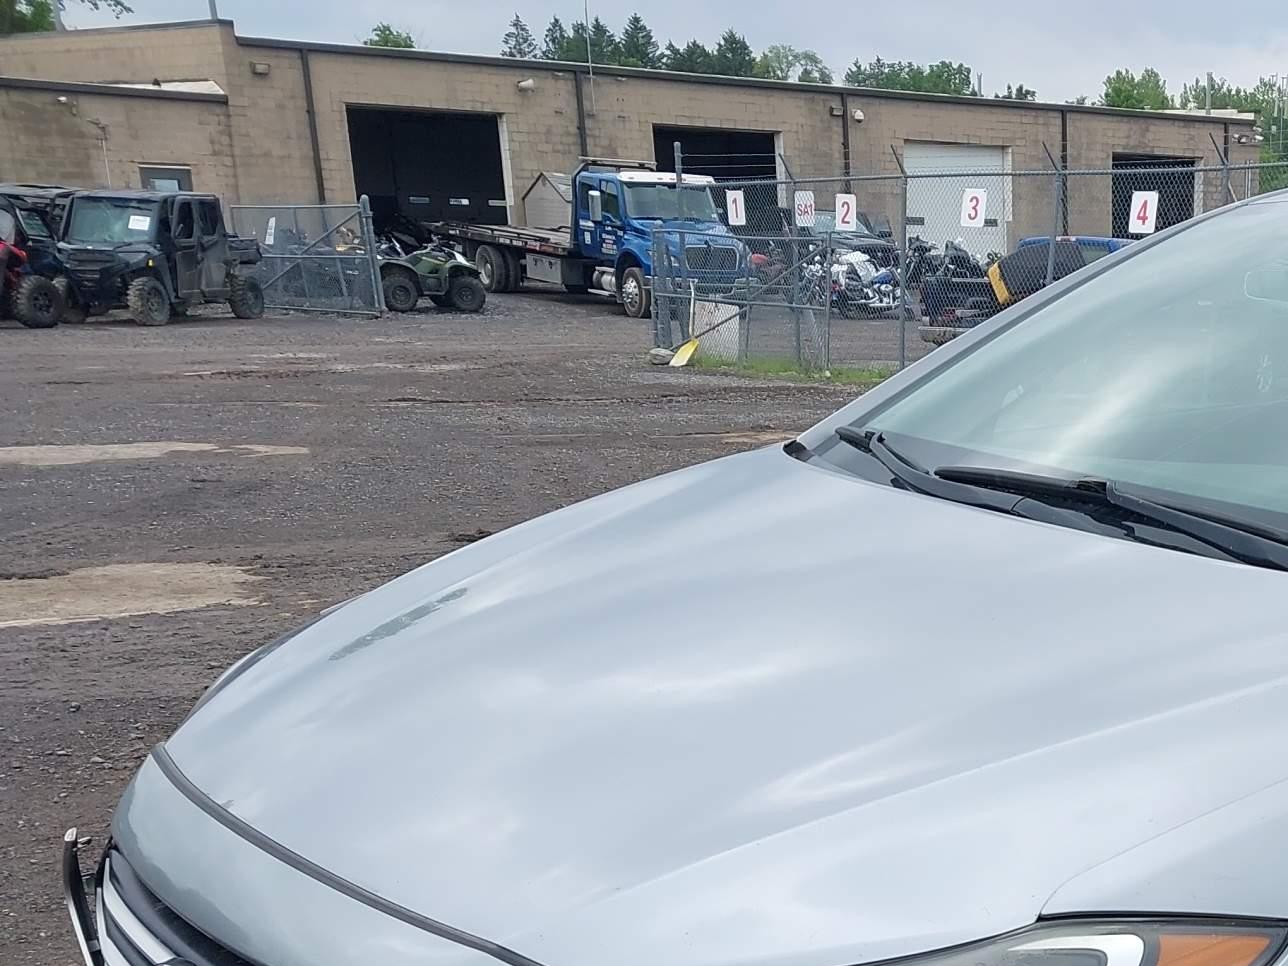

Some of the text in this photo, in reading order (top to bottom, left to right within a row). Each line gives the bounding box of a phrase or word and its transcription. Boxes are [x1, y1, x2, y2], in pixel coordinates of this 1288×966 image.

[731, 197, 738, 218] 1
[841, 201, 851, 225] 2
[968, 195, 979, 220] 3
[1136, 199, 1149, 226] 4
